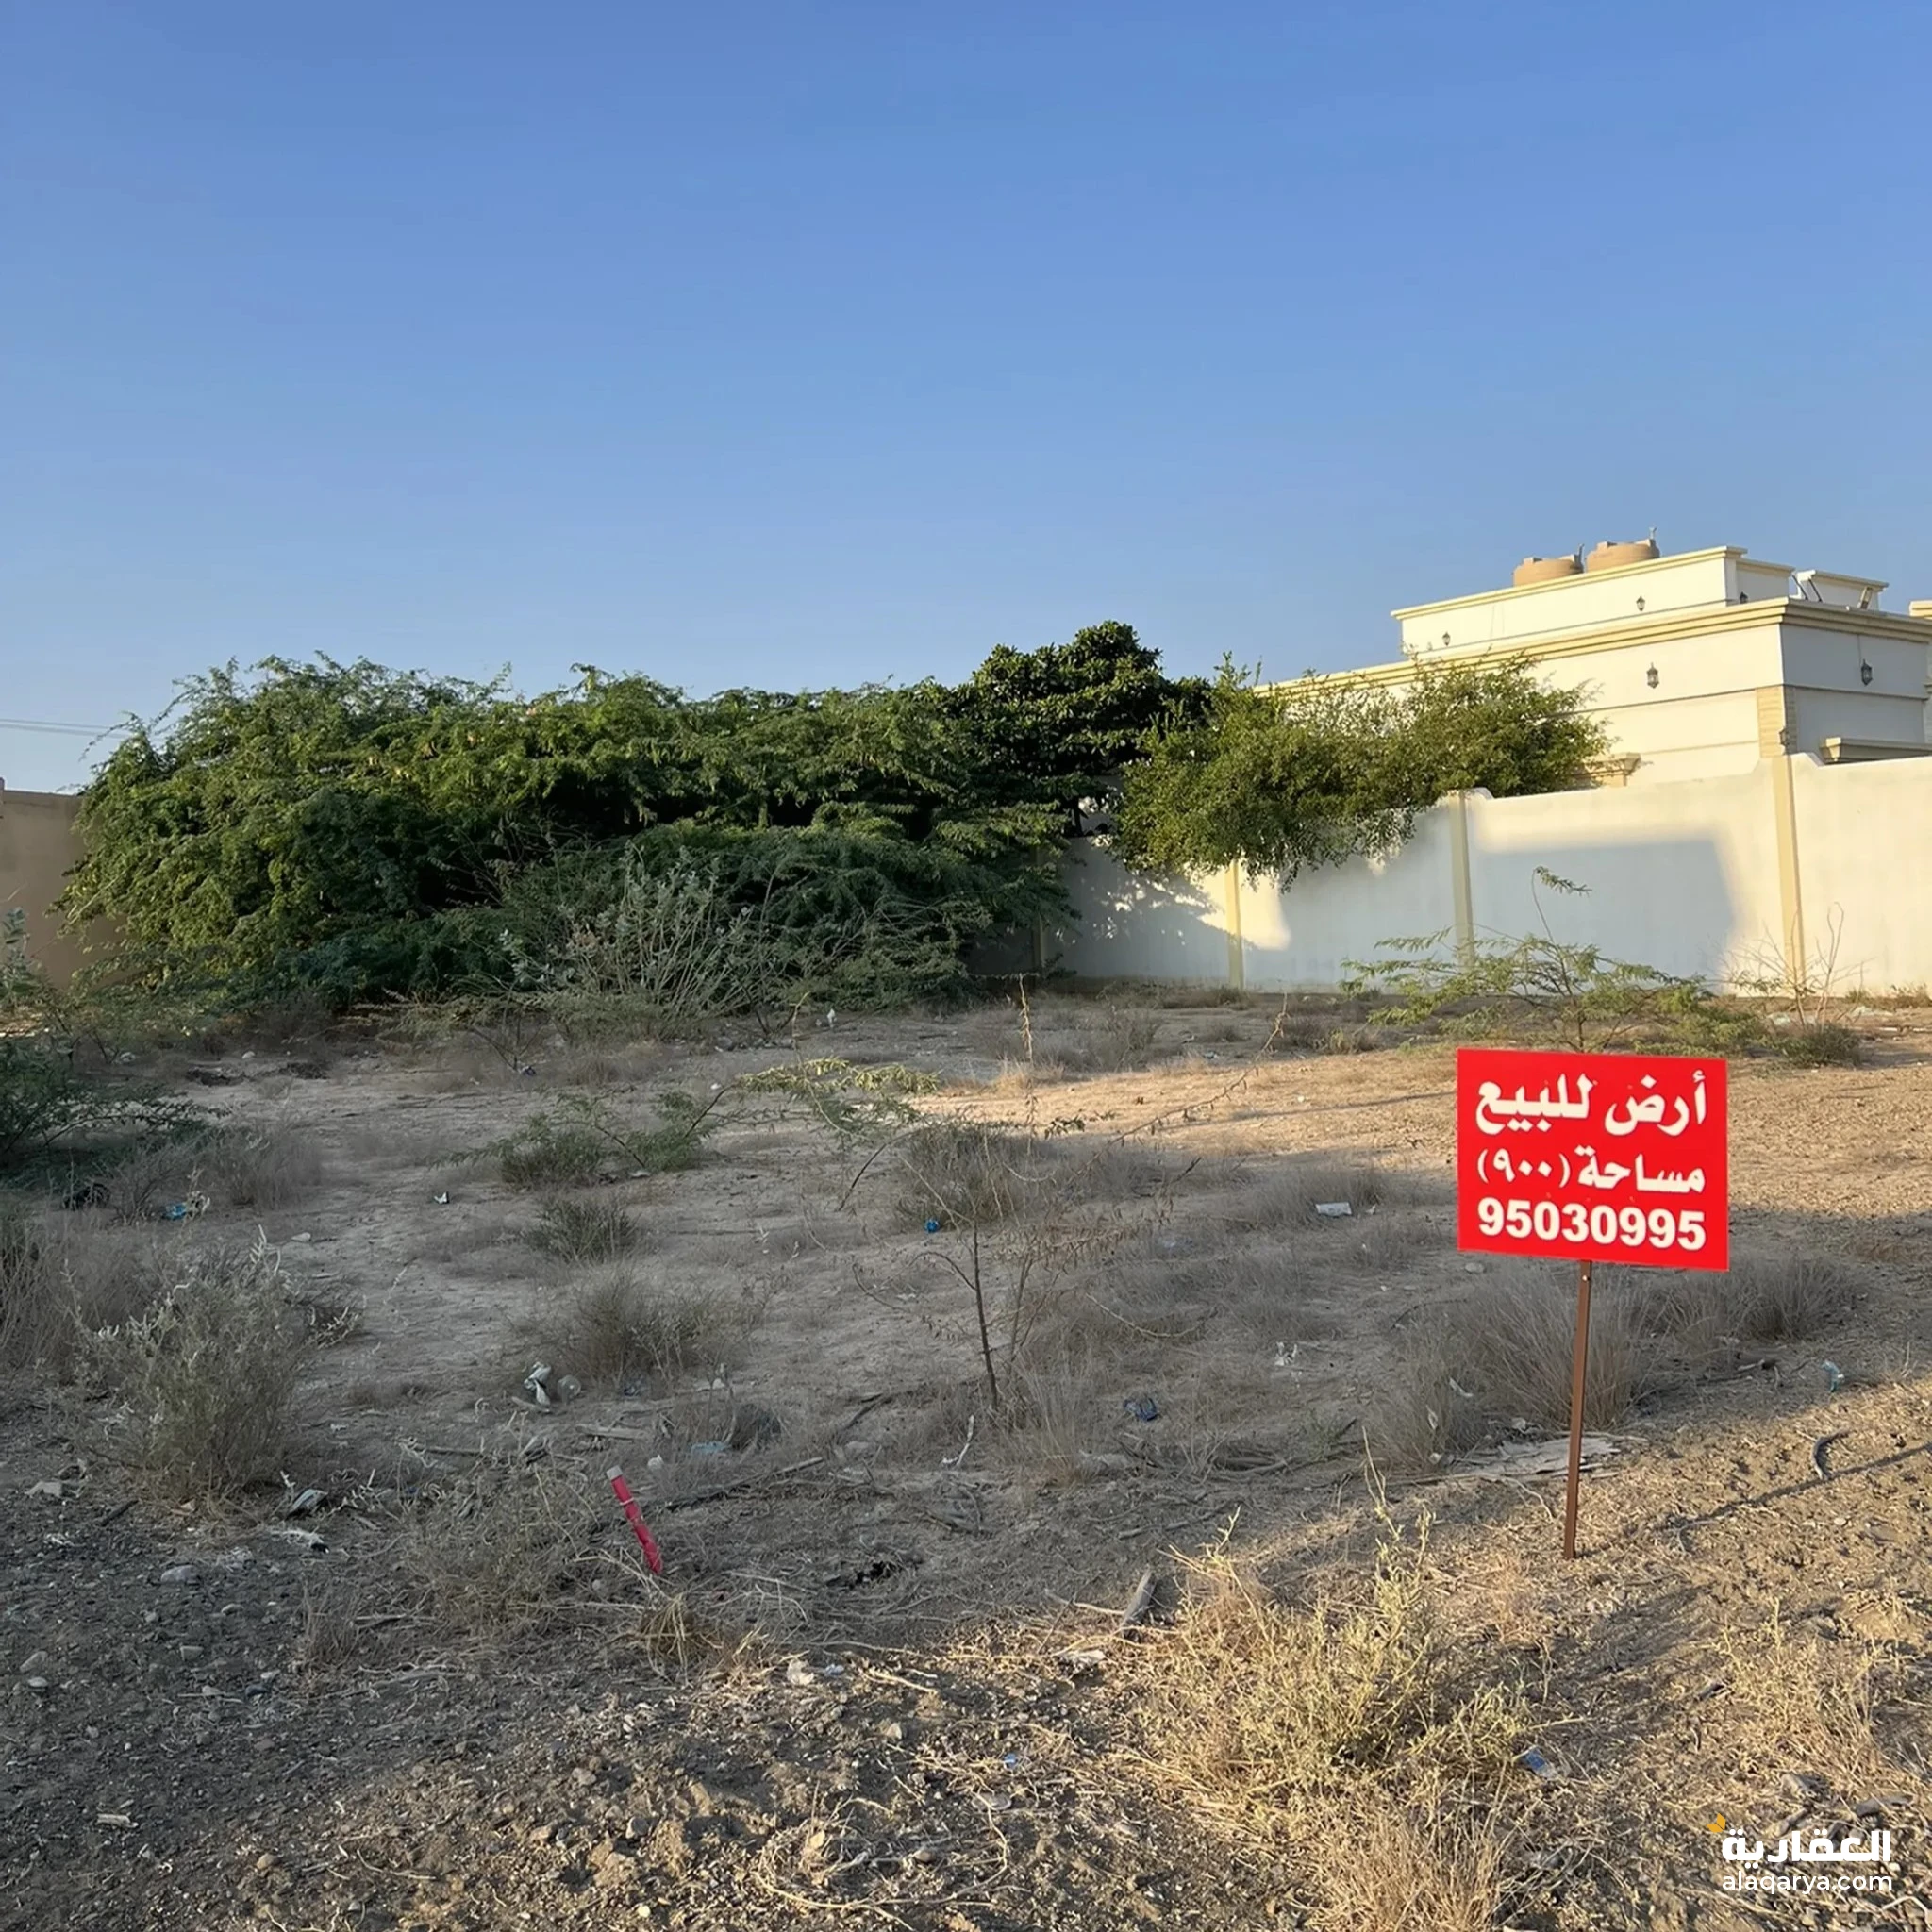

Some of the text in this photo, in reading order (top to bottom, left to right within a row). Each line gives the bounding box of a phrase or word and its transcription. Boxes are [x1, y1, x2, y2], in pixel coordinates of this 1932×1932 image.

[1475, 1070, 1707, 1136] أرض للبيع
[1574, 1144, 1706, 1193] مساحة
[1477, 1197, 1707, 1251] 95030995
